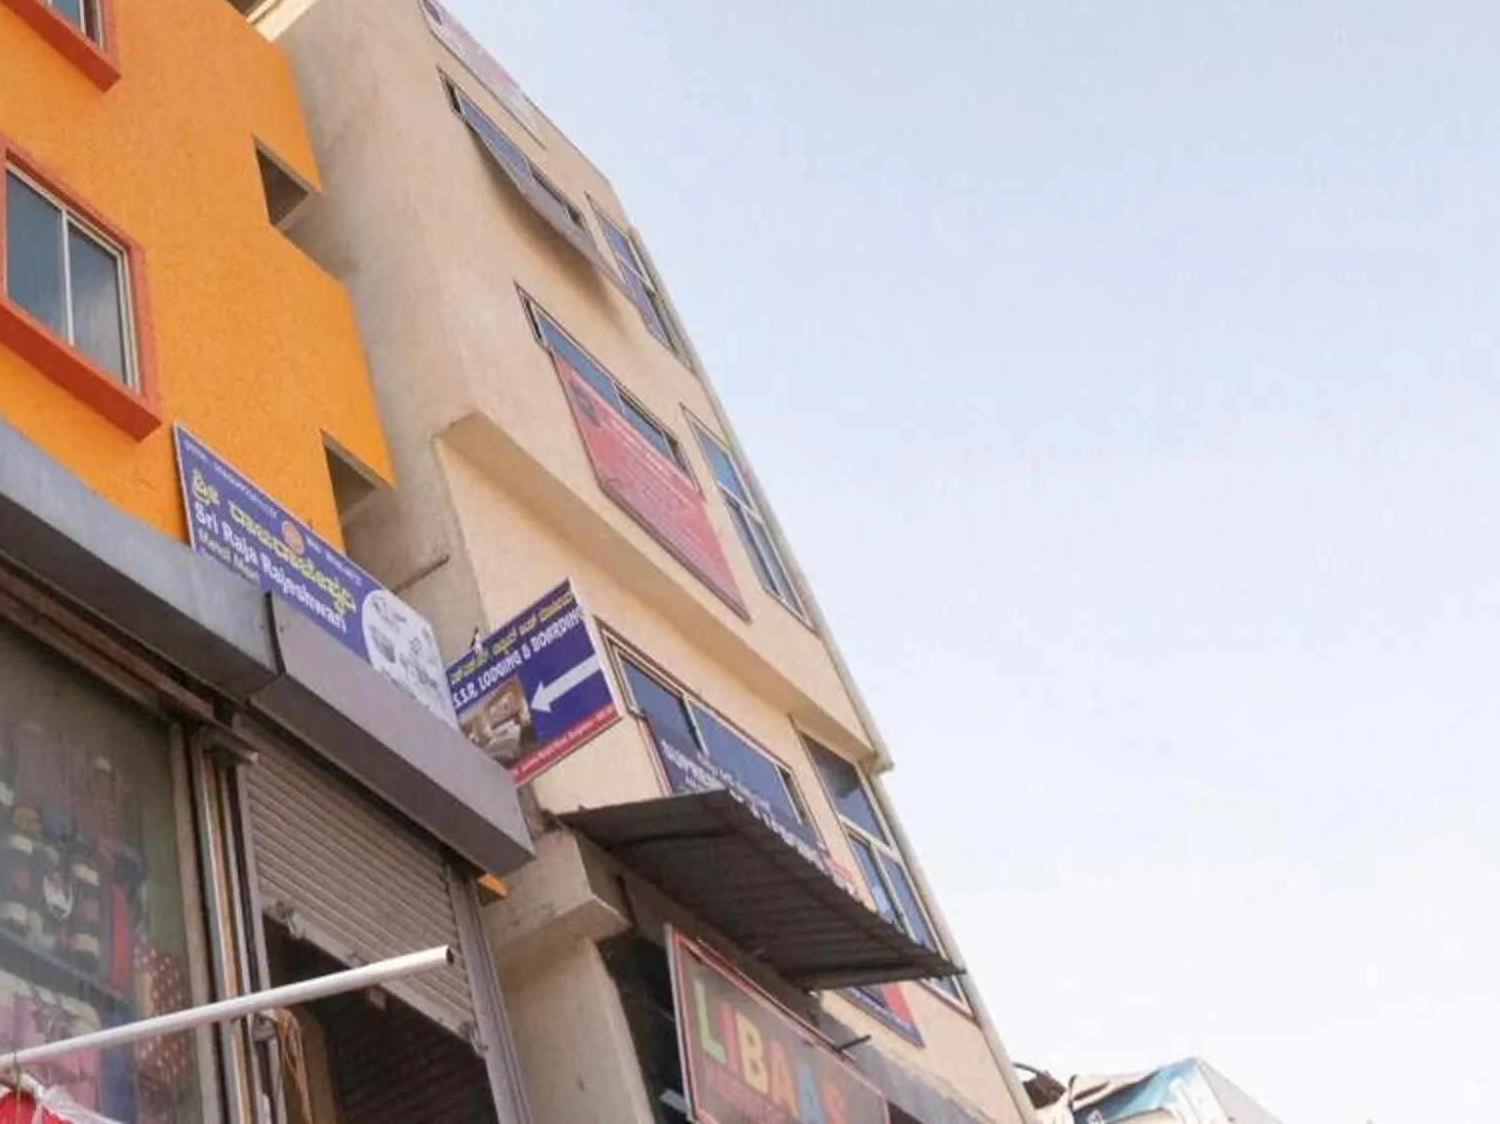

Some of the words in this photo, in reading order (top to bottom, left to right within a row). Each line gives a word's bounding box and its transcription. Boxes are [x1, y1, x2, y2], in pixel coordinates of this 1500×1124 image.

[193, 501, 219, 535] Sri
[222, 520, 259, 565] Raja
[479, 654, 523, 691] LODGING
